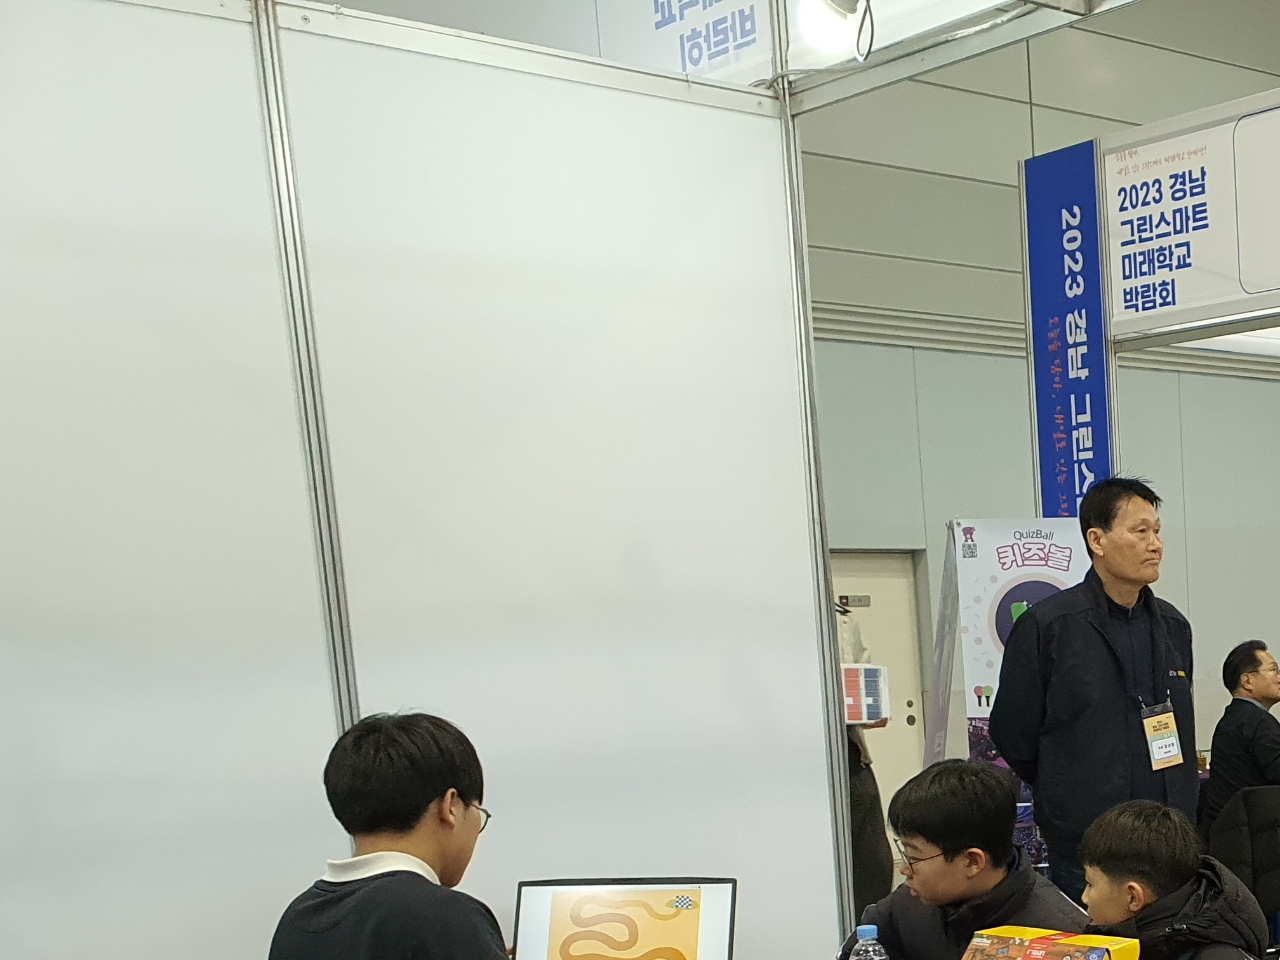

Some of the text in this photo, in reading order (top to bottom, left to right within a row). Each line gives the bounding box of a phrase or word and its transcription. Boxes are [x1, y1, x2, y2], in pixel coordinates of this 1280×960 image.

[1117, 166, 1207, 212] 2023 경남
[1120, 201, 1209, 247] 그린스마트
[1062, 205, 1085, 299] 2023
[1121, 241, 1192, 281] 미래학교
[1123, 278, 1176, 312] 박람회
[1066, 308, 1090, 380] 경남
[996, 542, 1073, 572] 퀴즈볼
[1013, 529, 1055, 542] QuizBall
